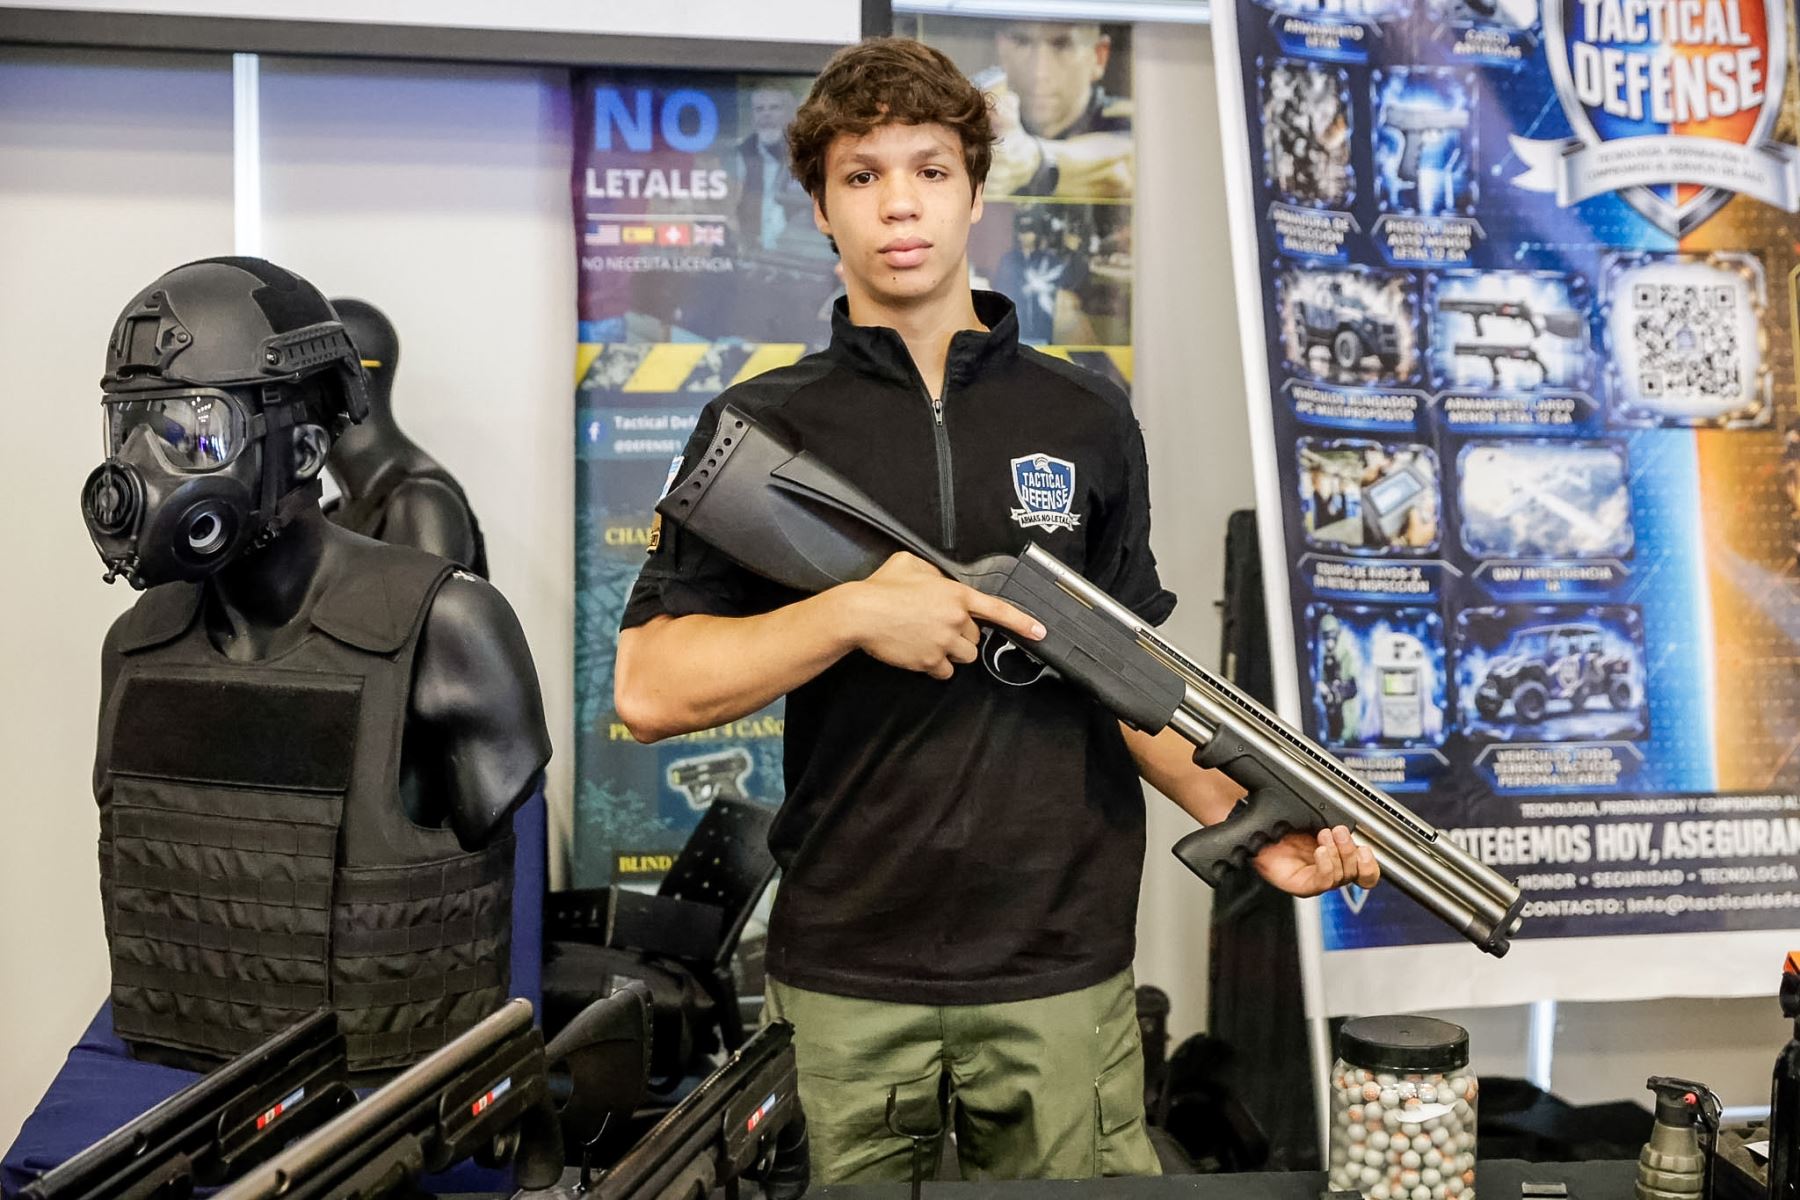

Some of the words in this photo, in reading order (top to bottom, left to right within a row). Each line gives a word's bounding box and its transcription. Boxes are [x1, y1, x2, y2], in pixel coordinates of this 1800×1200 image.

[1577, 0, 1751, 45] TACTICAL
[1573, 41, 1766, 123] DEFENSE
[595, 87, 719, 153] NO
[585, 167, 728, 199] LETALES
[582, 256, 604, 271] NO
[607, 256, 671, 271] NECESITA
[674, 256, 733, 271] LICENCIA
[614, 415, 668, 430] Tactical
[1022, 472, 1067, 489] TACTICAL
[1021, 484, 1069, 510] DEFENSE
[1020, 514, 1040, 524] ARMAS
[1041, 514, 1051, 522] NO
[1437, 824, 1592, 867] OTEGEMOS
[1595, 822, 1660, 865] HOY,
[619, 855, 675, 873] BLIND
[1518, 872, 1577, 891] HONOR
[1591, 868, 1684, 889] SEGURIDAD
[1520, 897, 1625, 918] CONTACTO:
